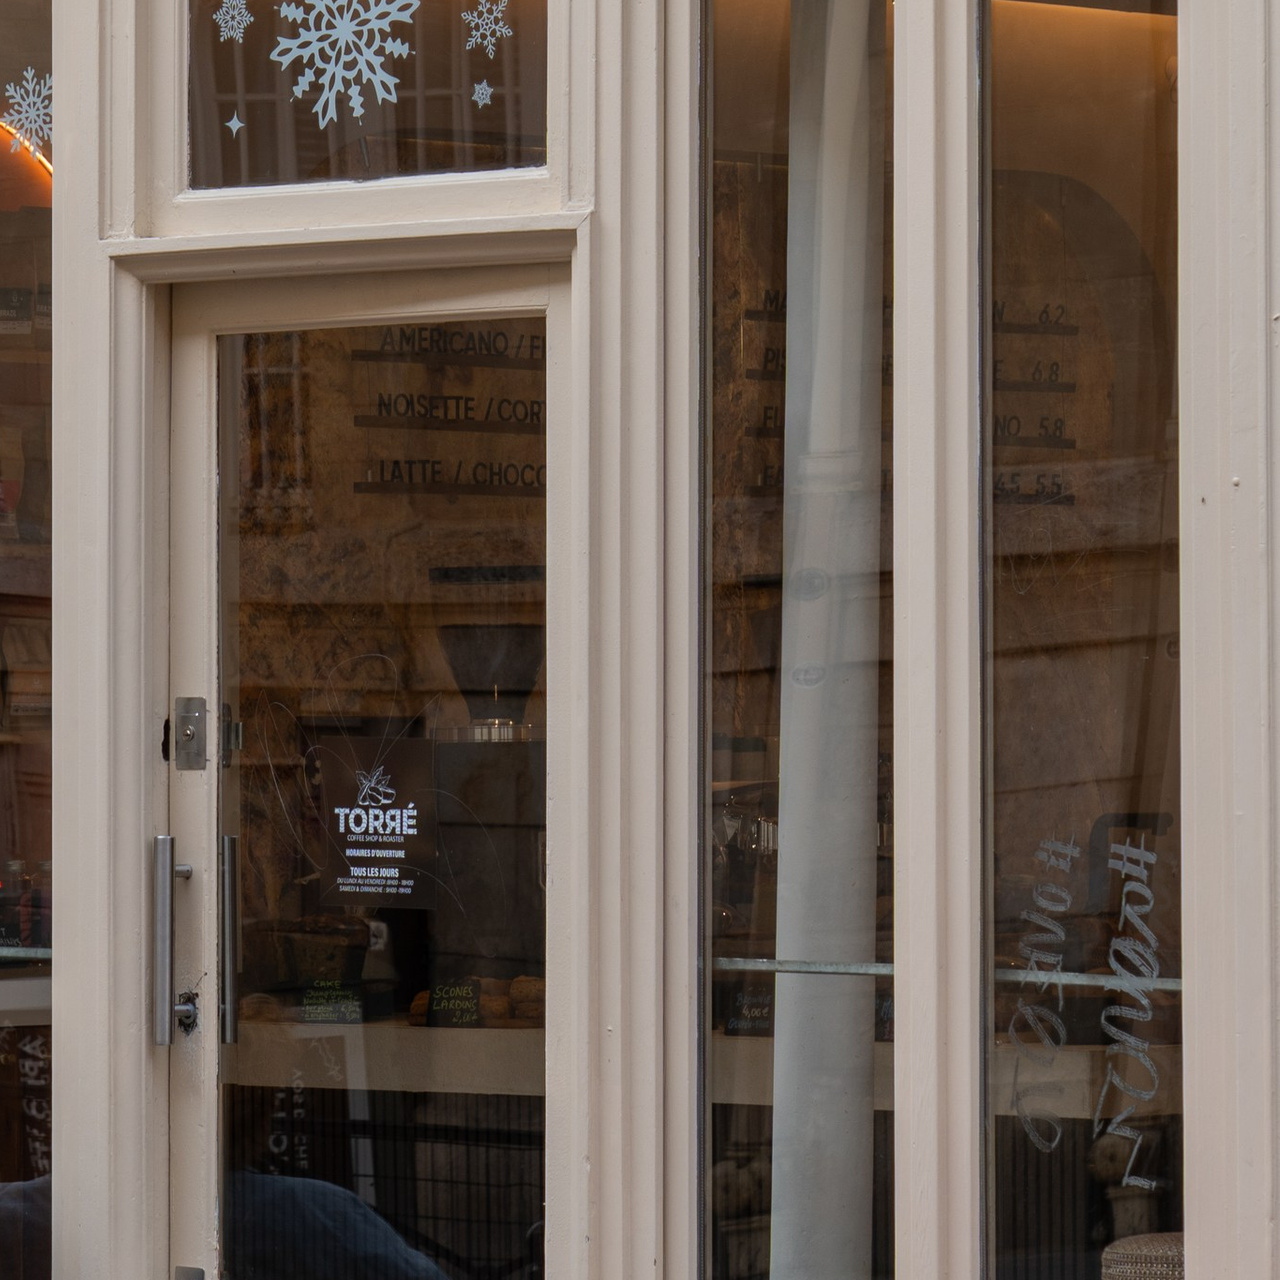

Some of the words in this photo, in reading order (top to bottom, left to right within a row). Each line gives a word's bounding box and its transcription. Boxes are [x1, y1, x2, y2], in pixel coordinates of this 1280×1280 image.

[380, 327, 510, 357] AMERICANO
[377, 392, 475, 421] NOISETTE
[379, 459, 443, 484] LATTE
[334, 802, 418, 835] TORRÉ
[347, 834, 365, 842] COFFEE
[382, 835, 405, 843] ROASTER
[345, 848, 371, 858] HORAIRES
[371, 849, 406, 859] D'OUVERTURE
[350, 866, 367, 877] TOUS
[367, 867, 380, 877] LES
[379, 868, 400, 878] JOURS
[313, 980, 342, 989] CAKE
[432, 985, 474, 999] SCONES
[432, 999, 478, 1011] LARDONS
